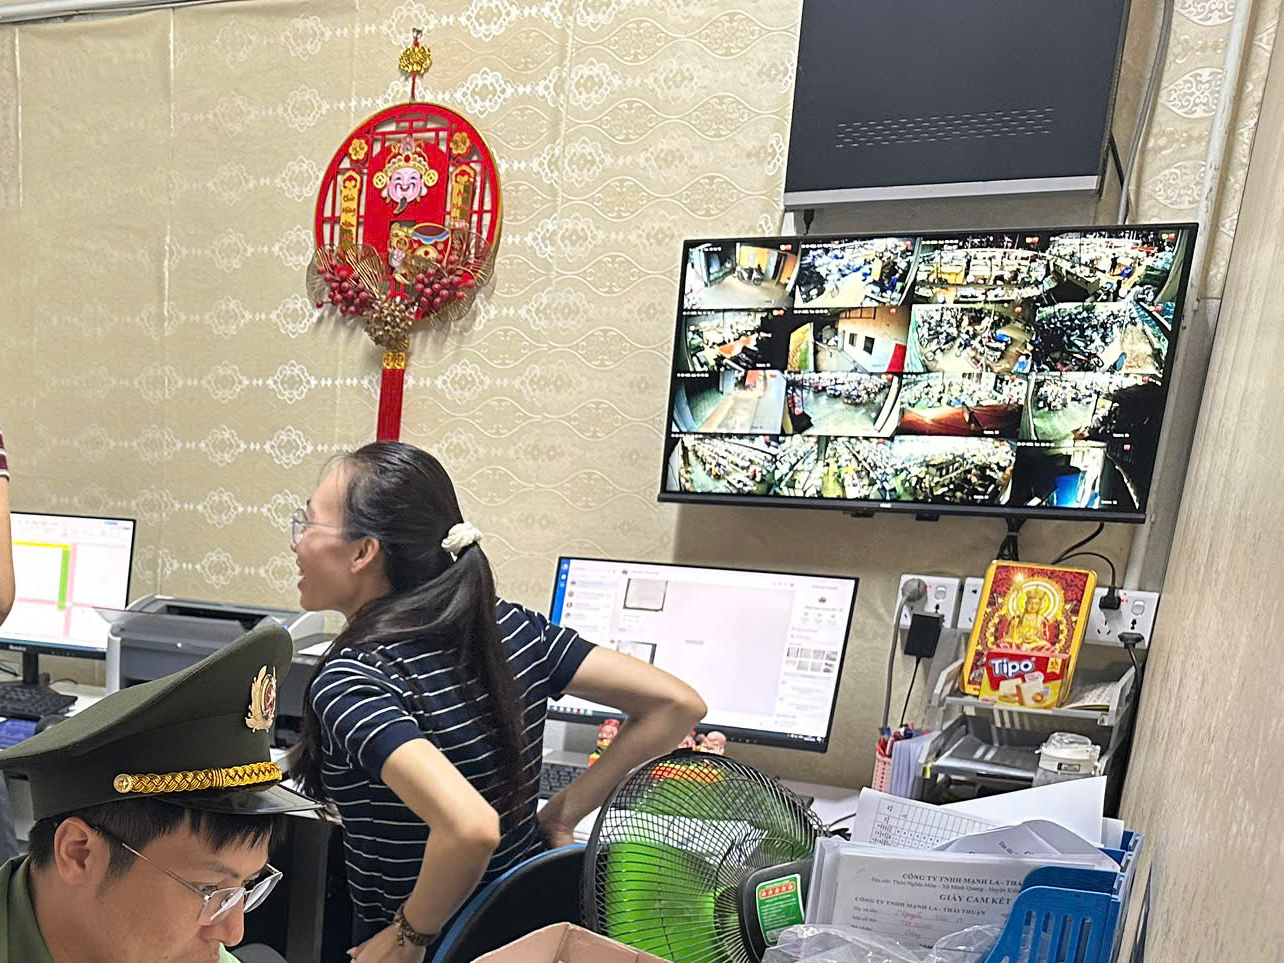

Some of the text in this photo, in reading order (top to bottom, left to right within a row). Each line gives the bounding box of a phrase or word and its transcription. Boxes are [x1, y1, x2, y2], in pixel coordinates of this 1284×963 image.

[990, 658, 1033, 678] Tipo
[902, 873, 925, 881] CÔNG
[939, 876, 962, 884] TNHH
[963, 878, 988, 886] MẠNH
[966, 895, 989, 904] CAM
